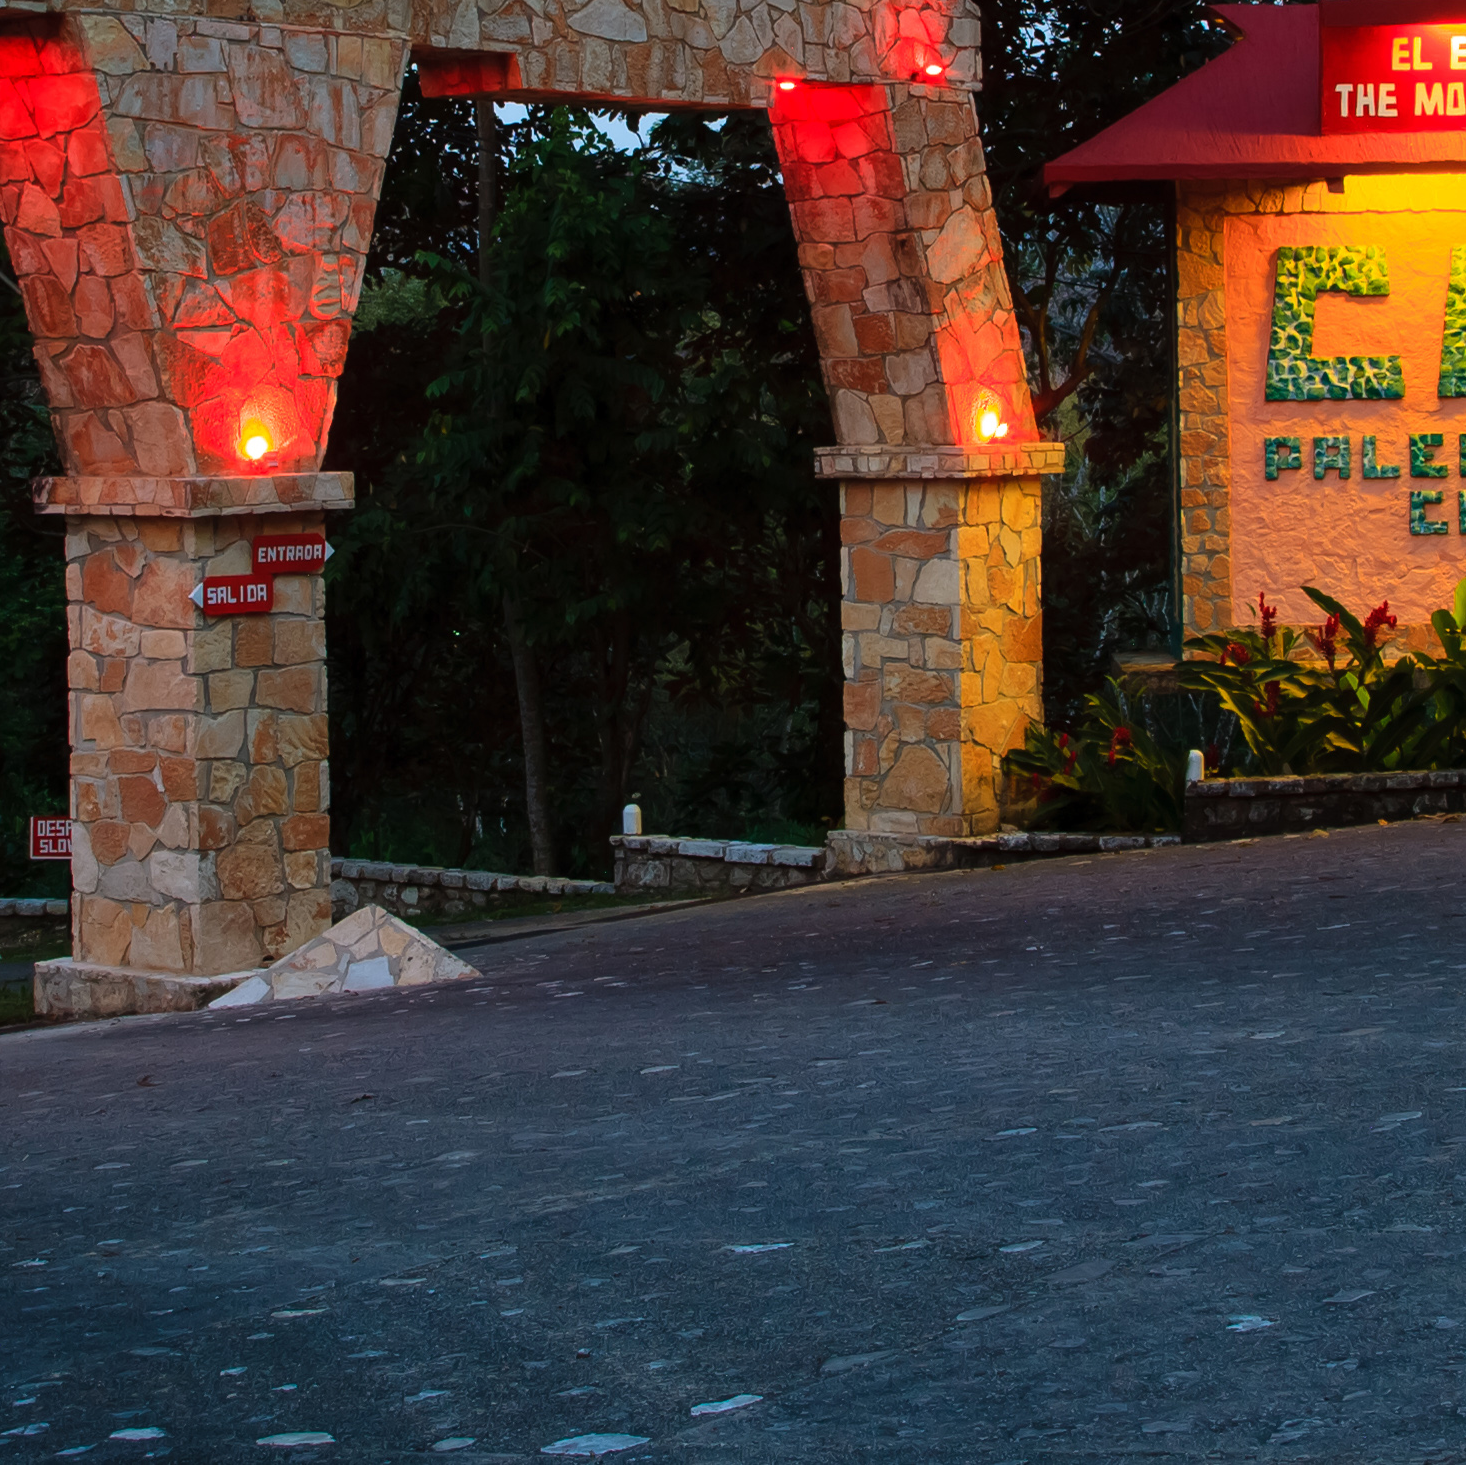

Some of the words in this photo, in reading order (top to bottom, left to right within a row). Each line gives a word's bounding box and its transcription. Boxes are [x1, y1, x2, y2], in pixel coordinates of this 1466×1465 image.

[1391, 37, 1433, 71] EL
[1335, 83, 1399, 118] THE
[257, 544, 323, 563] ENTRADA
[206, 584, 268, 605] SALIDA
